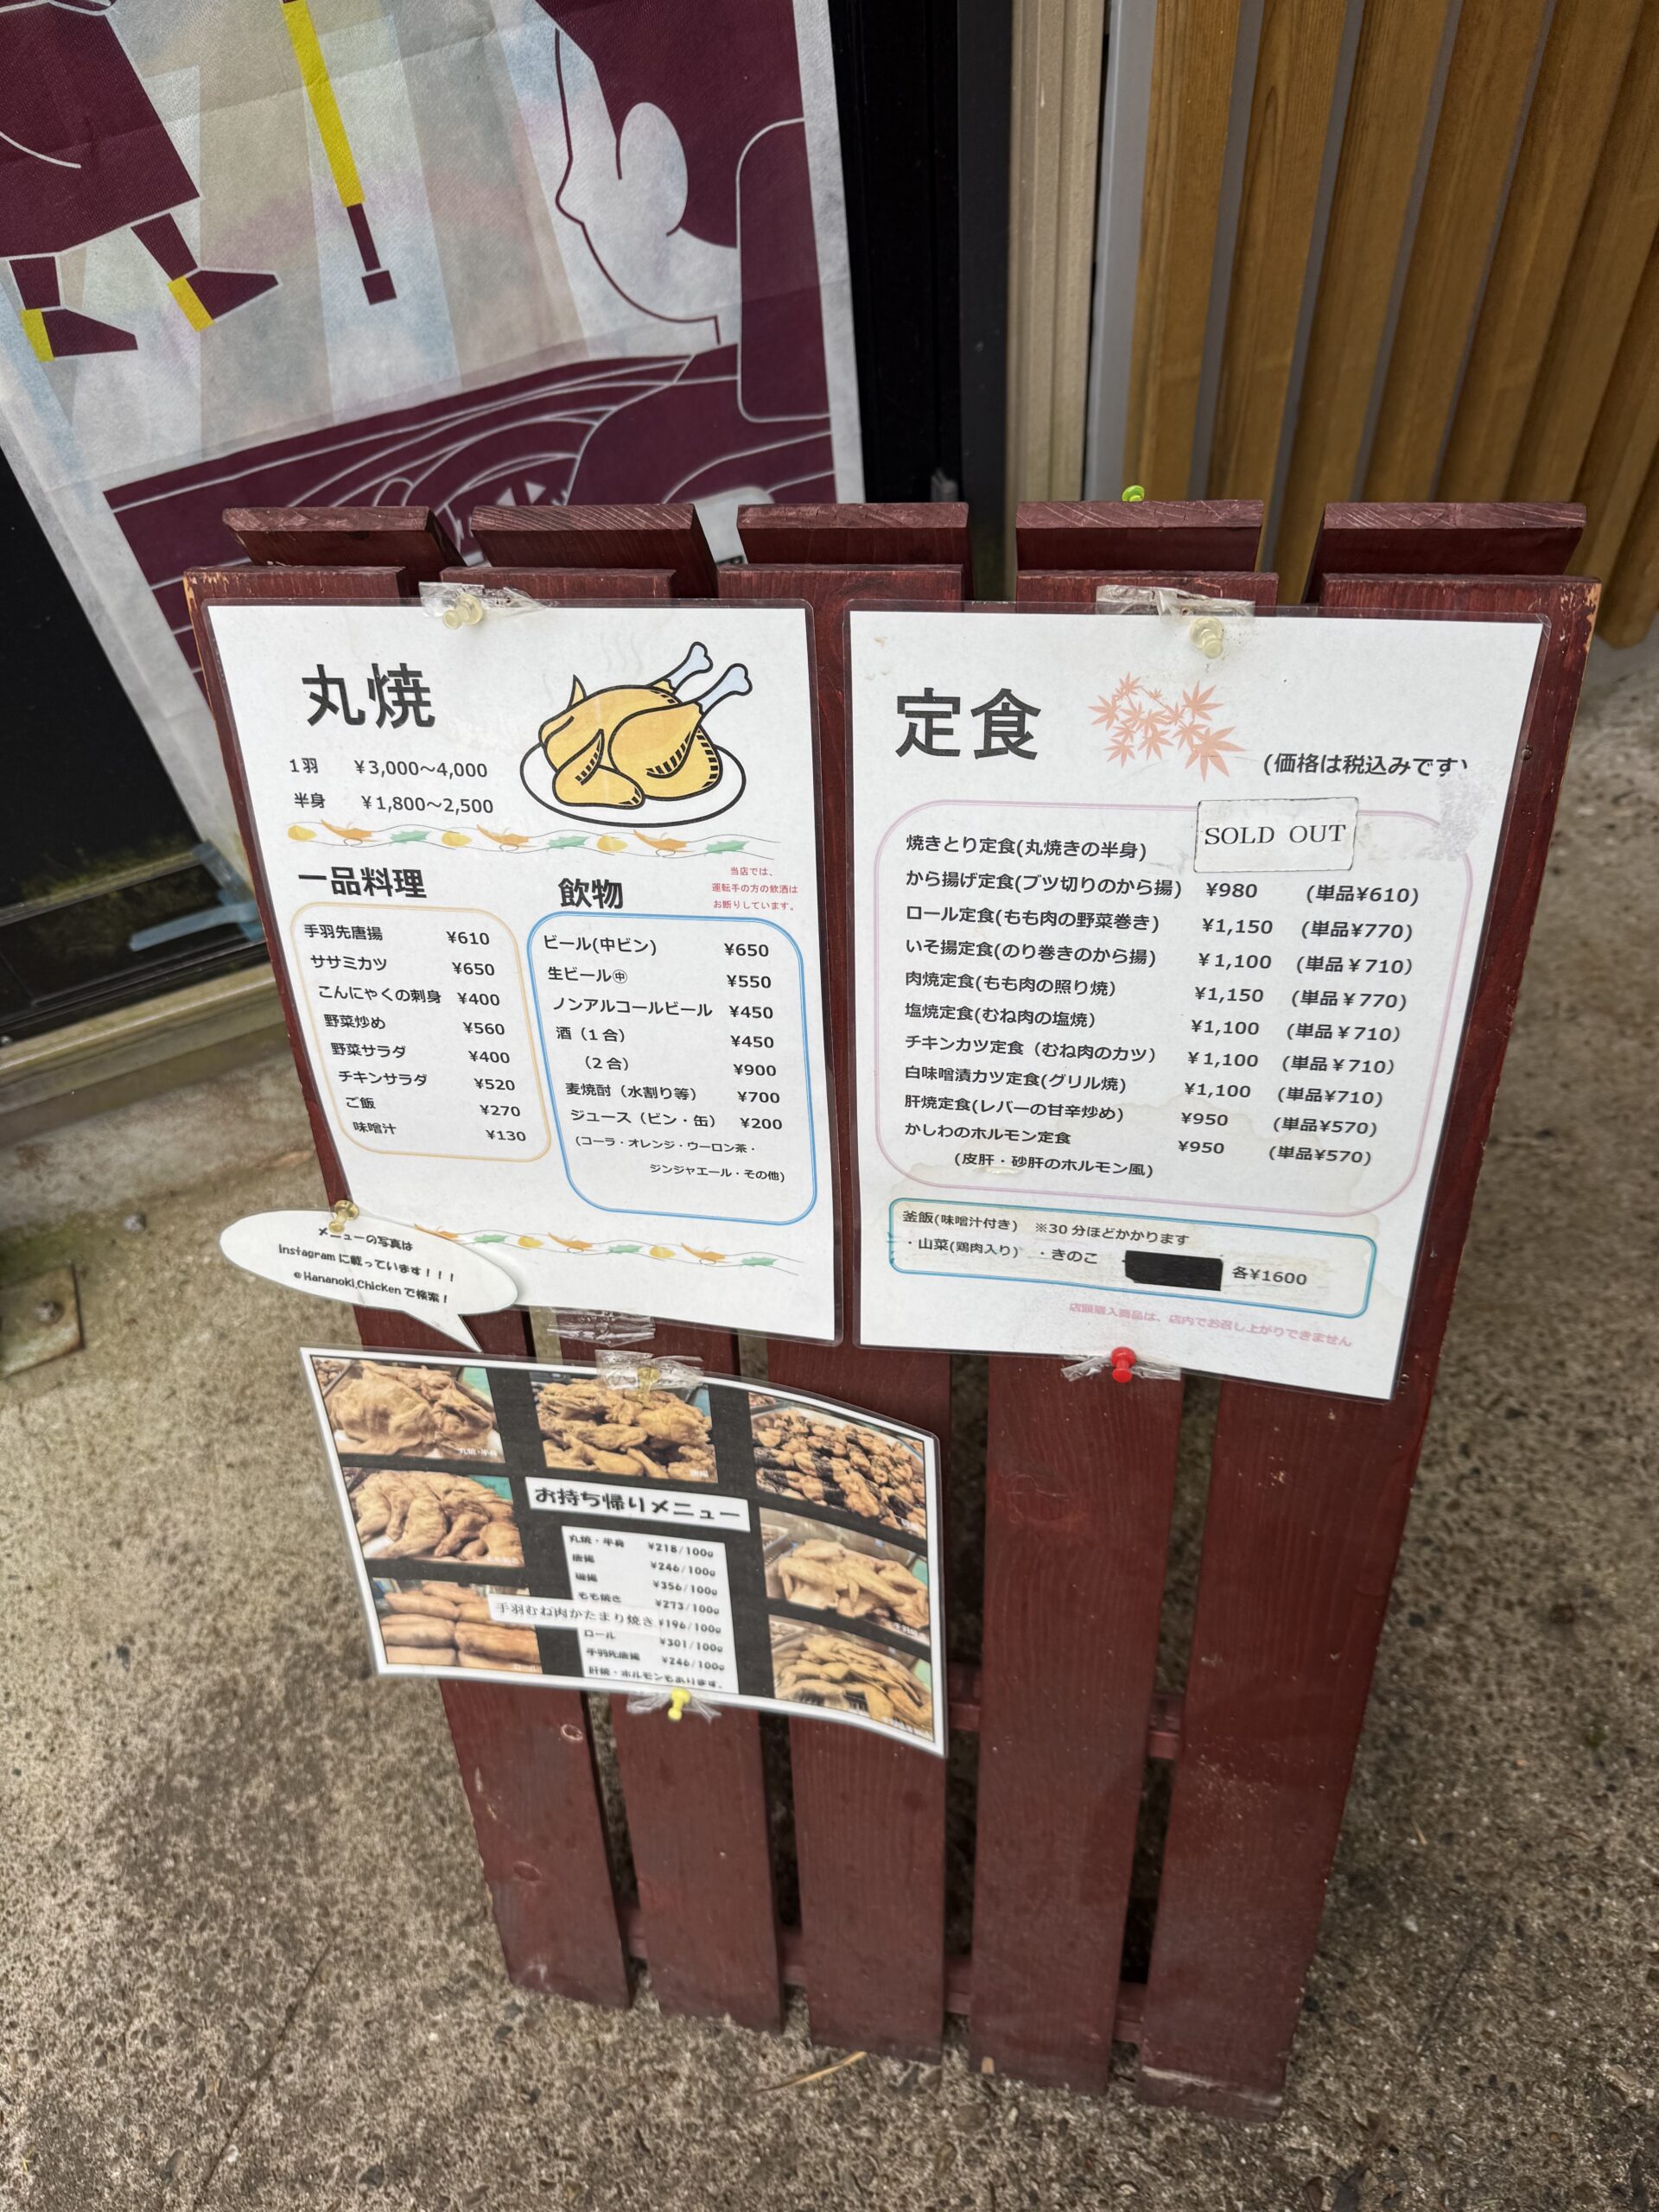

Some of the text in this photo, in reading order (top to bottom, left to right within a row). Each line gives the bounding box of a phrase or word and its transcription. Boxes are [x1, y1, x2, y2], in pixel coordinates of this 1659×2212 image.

[302, 663, 435, 728] 丸焼
[895, 688, 1041, 760] 定食
[290, 758, 318, 773] 1羽
[295, 792, 325, 808] 半身
[1205, 824, 1346, 844] SOLD OUT
[906, 835, 1146, 861] 焼きとり定食(丸焼きの半身)
[731, 867, 772, 876] 当店では、
[298, 867, 427, 898] 一品料理
[712, 883, 798, 893] 運転手の方の飲酒は
[906, 870, 1418, 906] から揚げ定食(ブツ切りのから揚) ¥980 (単品¥610)
[558, 878, 623, 909] 飲物
[714, 899, 793, 911] お断りしています。
[907, 906, 1412, 942] ロール定食(もも肉の野菜巻き) ¥1,150 (単品¥770)
[304, 925, 489, 944] 手羽先唐揚 ¥610
[544, 935, 768, 957] ビール(中ビン) ¥650
[311, 955, 494, 976] ササミカツ ¥650
[906, 939, 1412, 975] いそ揚定食(のり巻きのから揚) ¥1,100 (単品¥710)
[727, 975, 771, 988] ¥550
[906, 971, 1406, 1011] 肉焼定食(もも肉の照り焼) ¥1,150 (単品¥770)
[319, 986, 499, 1006] こんにゃくの刺身 ¥400
[554, 998, 772, 1019] ノンアルコールビール ¥450
[324, 1014, 505, 1035] 野菜炒め ¥560
[906, 1003, 1400, 1042] 塩焼定食(むね肉の塩焼) ¥1,100 (単品¥710)
[731, 1035, 773, 1048] ¥450
[331, 1043, 510, 1063] 野菜サラダ ¥400
[906, 1035, 1394, 1074] チキンカツ定食(むね肉のカツ) ¥1,100 (単品¥710)
[339, 1071, 515, 1090] チキンサラダ ¥520
[734, 1065, 776, 1076] ¥900
[906, 1065, 1382, 1108] 白味噌漬カツ定食(グリル焼) ¥1,100 (単品¥710)
[346, 1096, 520, 1116] ご飯 ¥270
[737, 1091, 779, 1103] ¥700
[741, 1118, 782, 1129] ¥200
[905, 1095, 1376, 1137] 肝焼定食(レバーの甘辛炒め) ¥950 (単品¥570)
[353, 1122, 525, 1141] 味噌汁 ¥130
[906, 1123, 1370, 1166] かしわのホルモン定食 ¥950 (単品¥570)
[651, 1164, 785, 1182] ジンジャエール・その他)
[955, 1153, 1153, 1178] (皮肝・砂肝のホルモン風)
[903, 1211, 1017, 1232] 釜飯(味噌汁付き)
[279, 1244, 335, 1261] Instagram
[1232, 1266, 1306, 1285] 各¥1600
[536, 1488, 740, 1519] お持ち帰りメニュー
[649, 1543, 713, 1557] ¥218/100g
[651, 1561, 715, 1577] ¥246/100g
[653, 1580, 717, 1596] ¥356/100g
[498, 1602, 653, 1627] 手羽むね肉かたまり焼き
[656, 1599, 719, 1615] ¥273/100g
[660, 1637, 722, 1653] ¥301/100g
[662, 1656, 725, 1671] ¥246/100g
